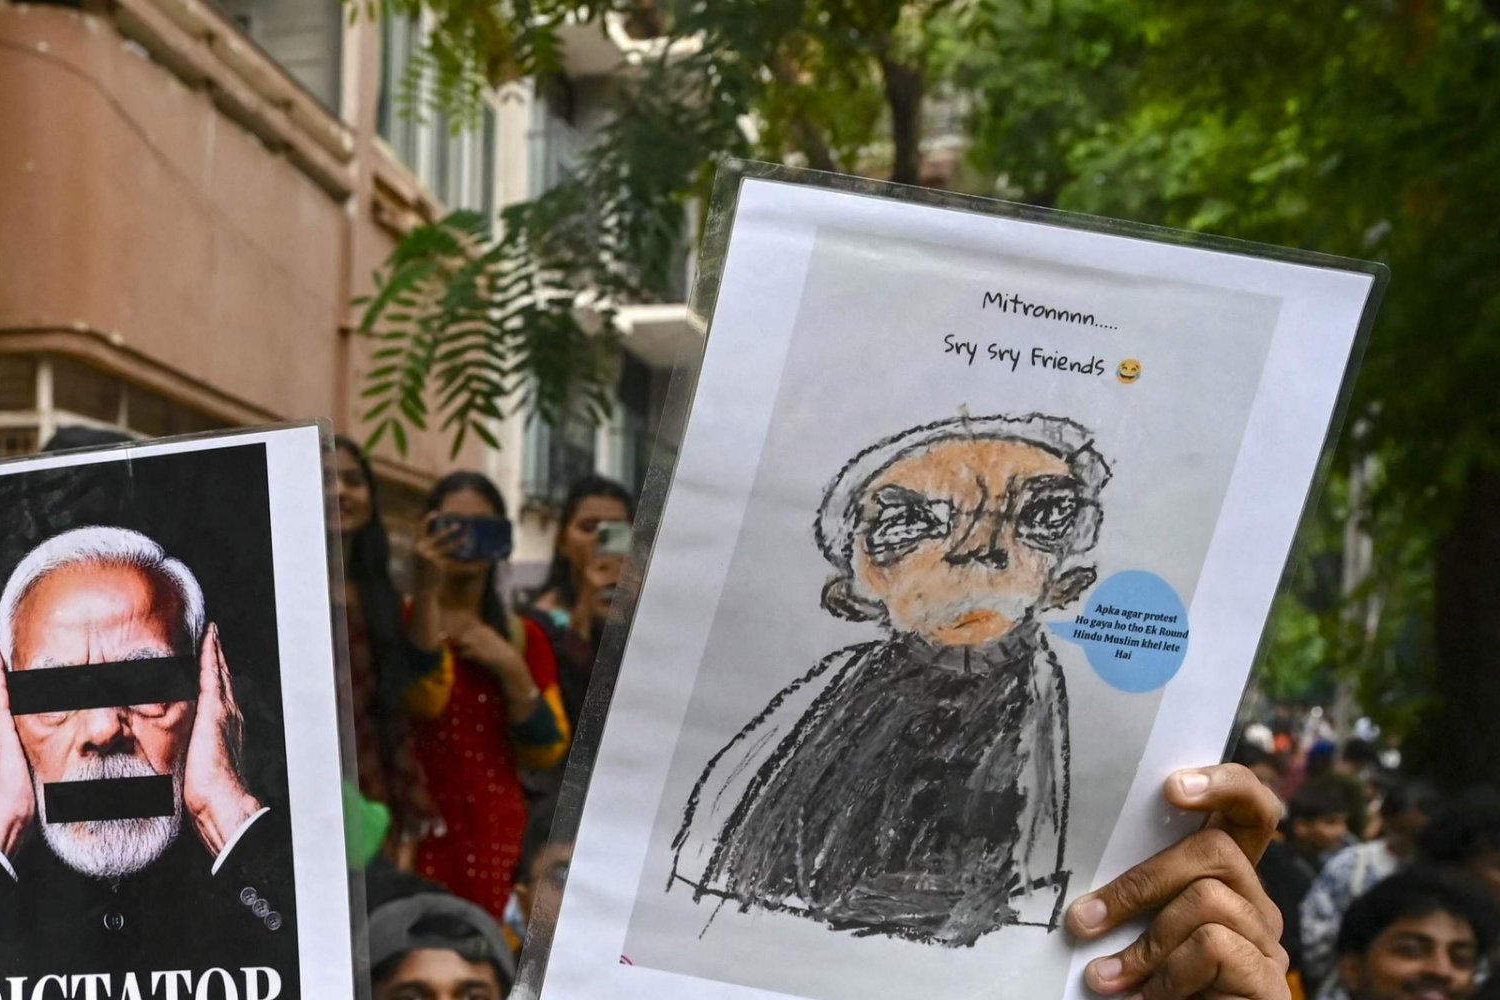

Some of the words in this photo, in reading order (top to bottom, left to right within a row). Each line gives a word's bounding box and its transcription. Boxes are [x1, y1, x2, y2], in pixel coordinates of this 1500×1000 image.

[944, 334, 977, 366] Sry
[1031, 348, 1105, 376] Friends
[1095, 604, 1119, 615] Apka
[1121, 608, 1143, 619] agar
[1143, 612, 1177, 623] protest
[1075, 615, 1088, 625] Ho
[1090, 618, 1113, 630] gaya
[1114, 620, 1126, 631] ho
[1128, 622, 1143, 633] tho
[1145, 625, 1157, 635] Ek
[1158, 628, 1189, 639] Round
[1073, 629, 1102, 641] Hindu
[1103, 633, 1140, 647] Muslim
[1141, 639, 1162, 651] khel
[1162, 641, 1180, 652] lete
[1114, 649, 1132, 660] Hai
